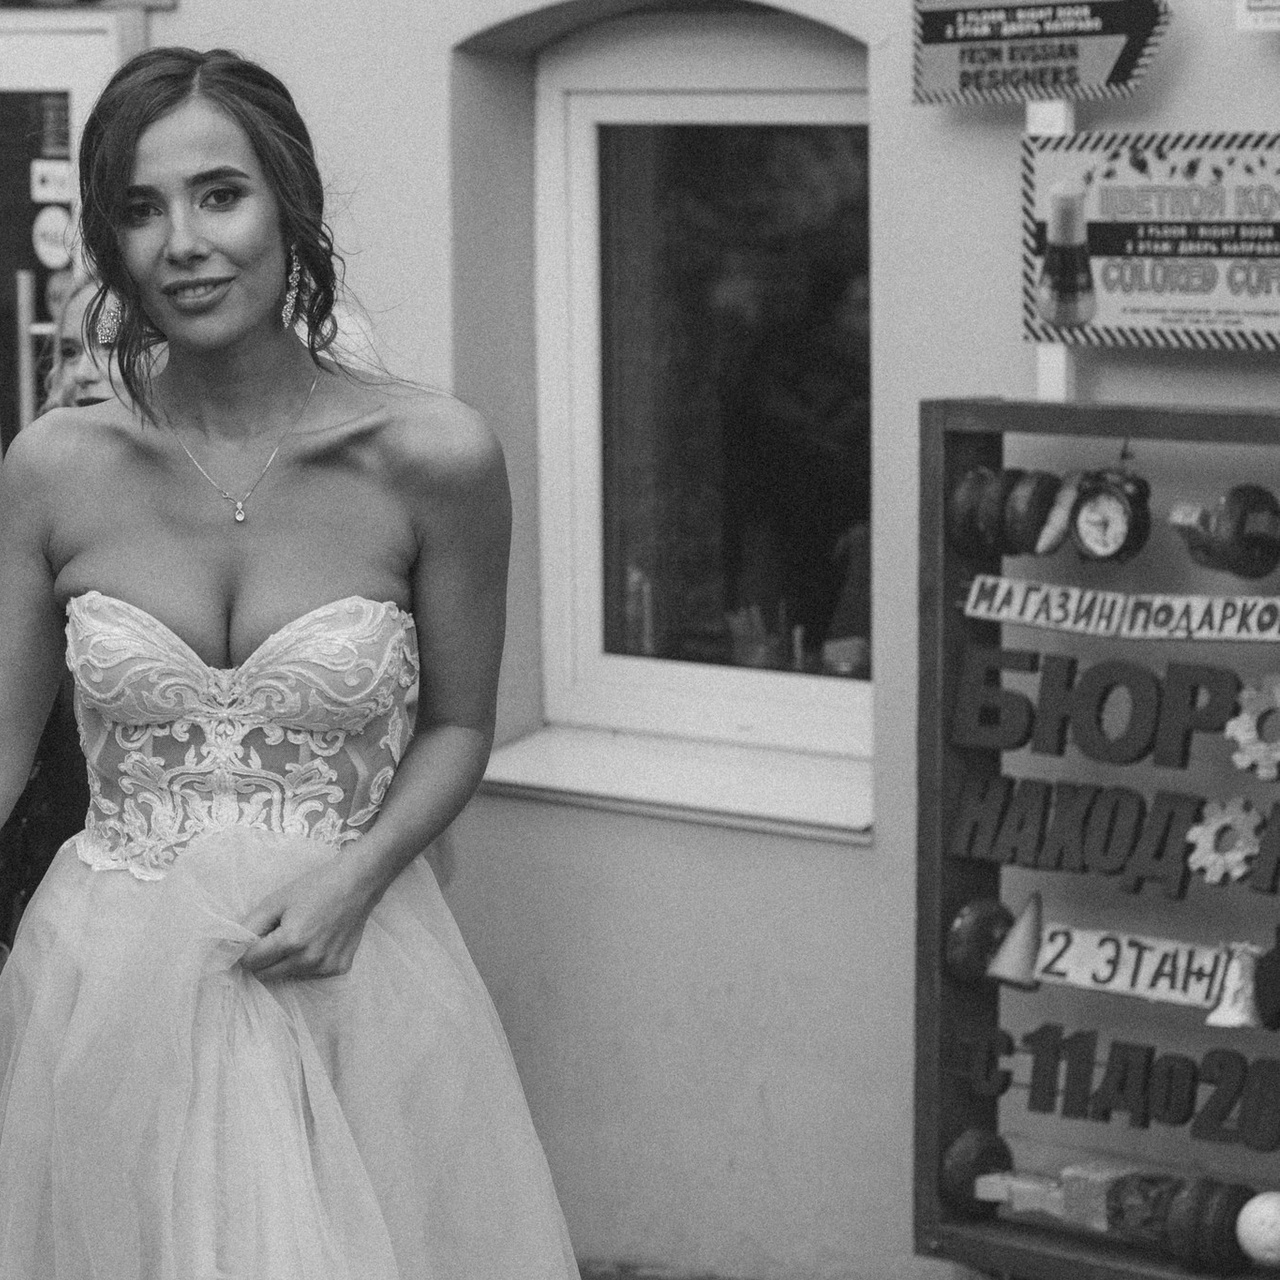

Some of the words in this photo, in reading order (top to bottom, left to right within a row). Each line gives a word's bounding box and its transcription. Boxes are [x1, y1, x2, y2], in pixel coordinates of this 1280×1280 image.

[959, 46, 1004, 65] FROM
[1008, 43, 1079, 62] RUSSIAN
[959, 66, 1080, 90] DESIGNERS
[1234, 183, 1280, 217] КО
[1101, 258, 1219, 294] COLORED
[1226, 258, 1280, 297] COF
[972, 578, 1118, 631] МАГАЗИН
[1128, 594, 1280, 638] ПОДАРКО
[1041, 930, 1073, 977] 2
[1091, 936, 1221, 1001] ЭТАЖ
